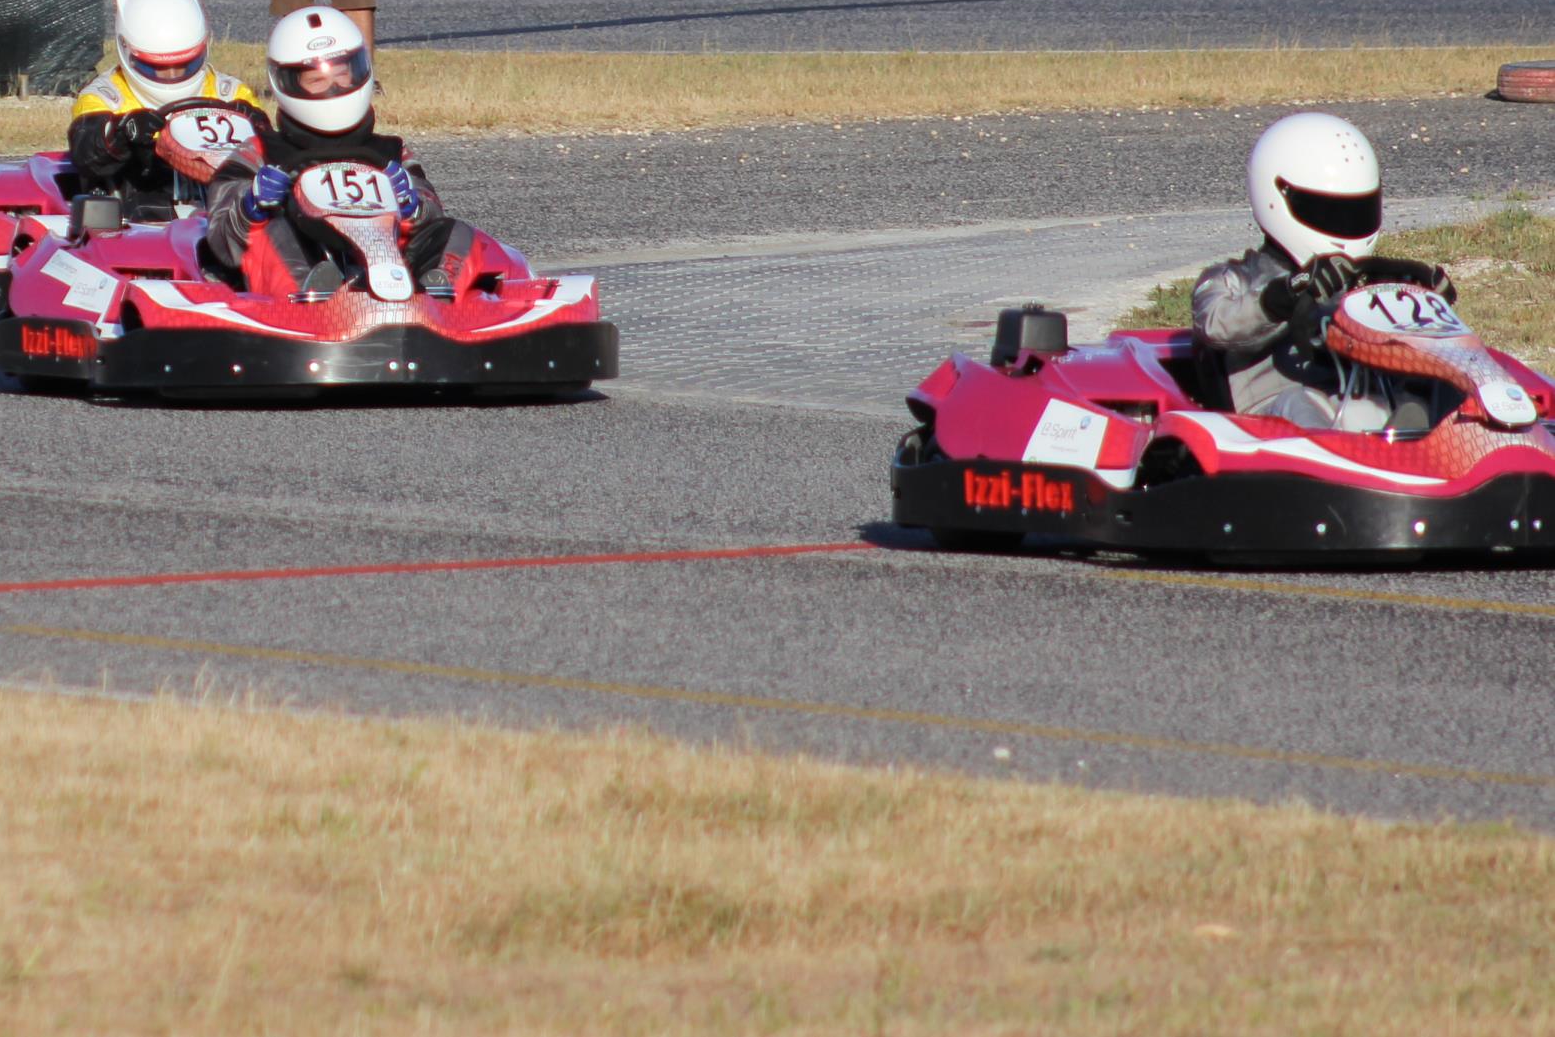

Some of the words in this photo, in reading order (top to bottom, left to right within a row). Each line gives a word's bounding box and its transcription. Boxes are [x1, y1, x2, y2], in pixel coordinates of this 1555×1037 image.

[196, 116, 242, 144] 52
[320, 170, 383, 203] 151
[1368, 291, 1458, 325] 128
[964, 468, 1074, 511] Izzi-Flex
